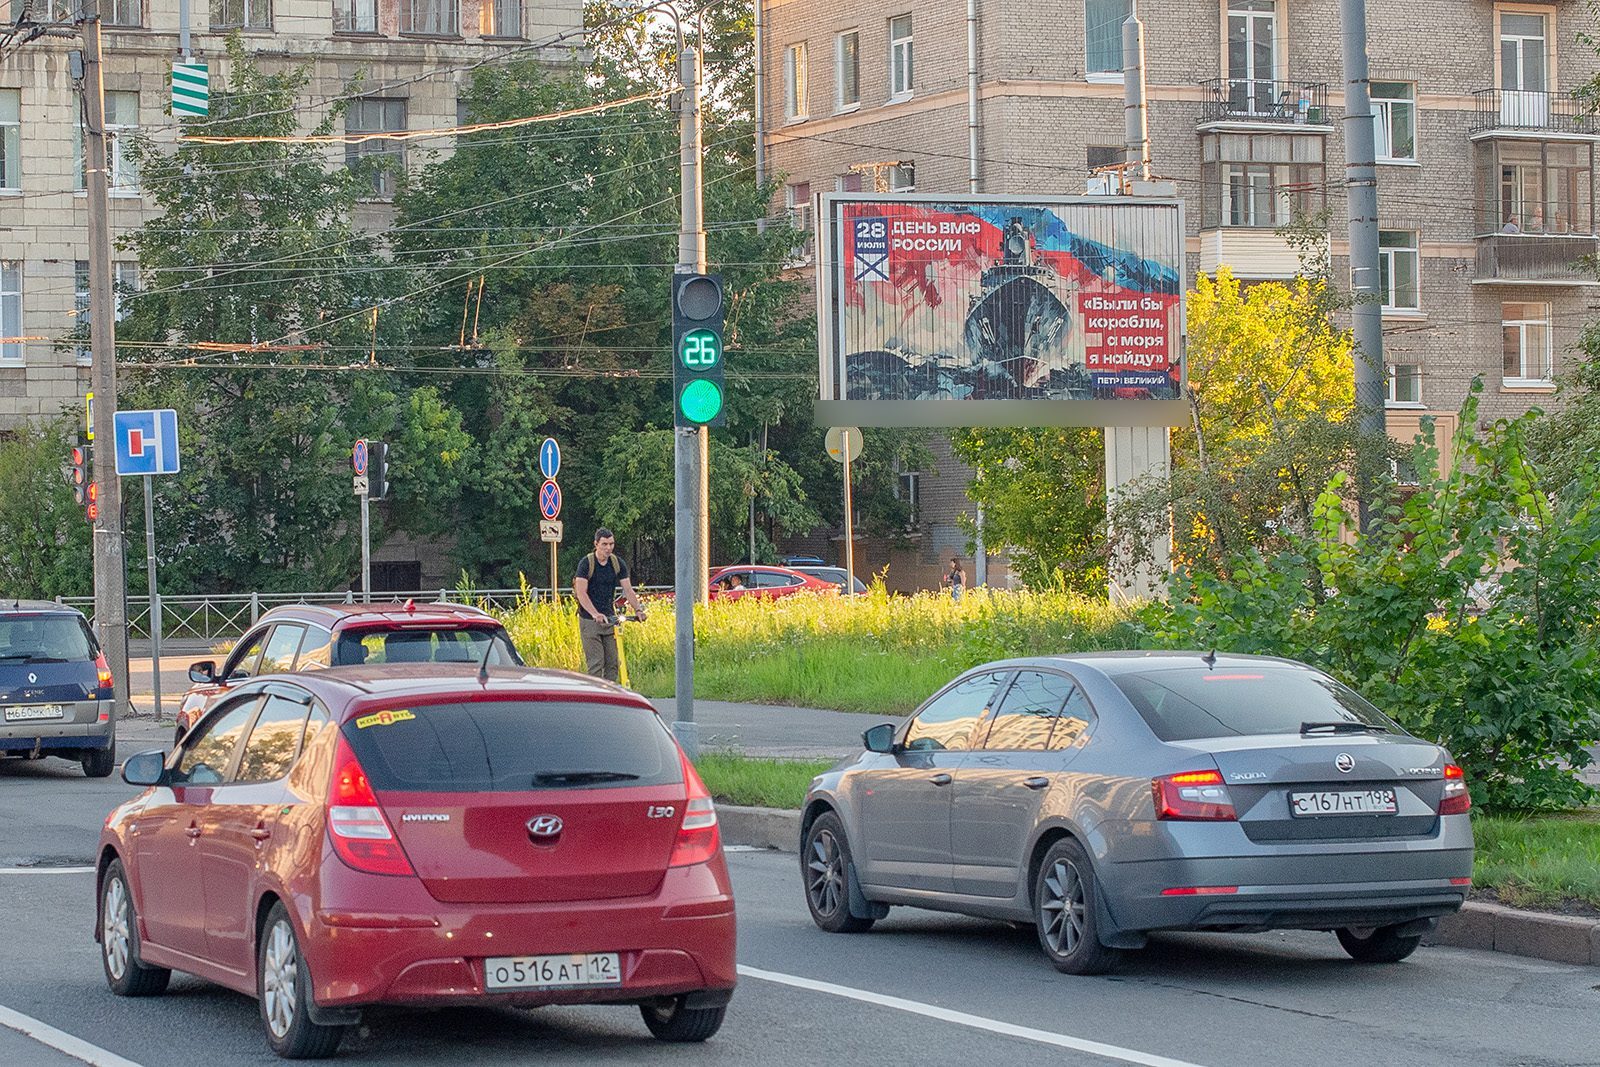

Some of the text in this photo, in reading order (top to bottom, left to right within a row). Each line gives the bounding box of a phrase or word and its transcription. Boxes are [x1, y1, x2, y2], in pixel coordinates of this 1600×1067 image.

[857, 222, 886, 238] 28
[891, 221, 980, 236] ДЕНЬ ВМФ
[891, 238, 962, 251] РОССИИ
[1083, 297, 1164, 311] «Были бы
[1088, 315, 1165, 330] корабли,
[1106, 335, 1165, 348] а моря
[685, 336, 715, 364] 26
[1089, 350, 1165, 366] я найду»
[1123, 375, 1165, 384] ВЕЛИКИЙ
[1366, 791, 1391, 804] 198
[590, 956, 611, 973] 12
